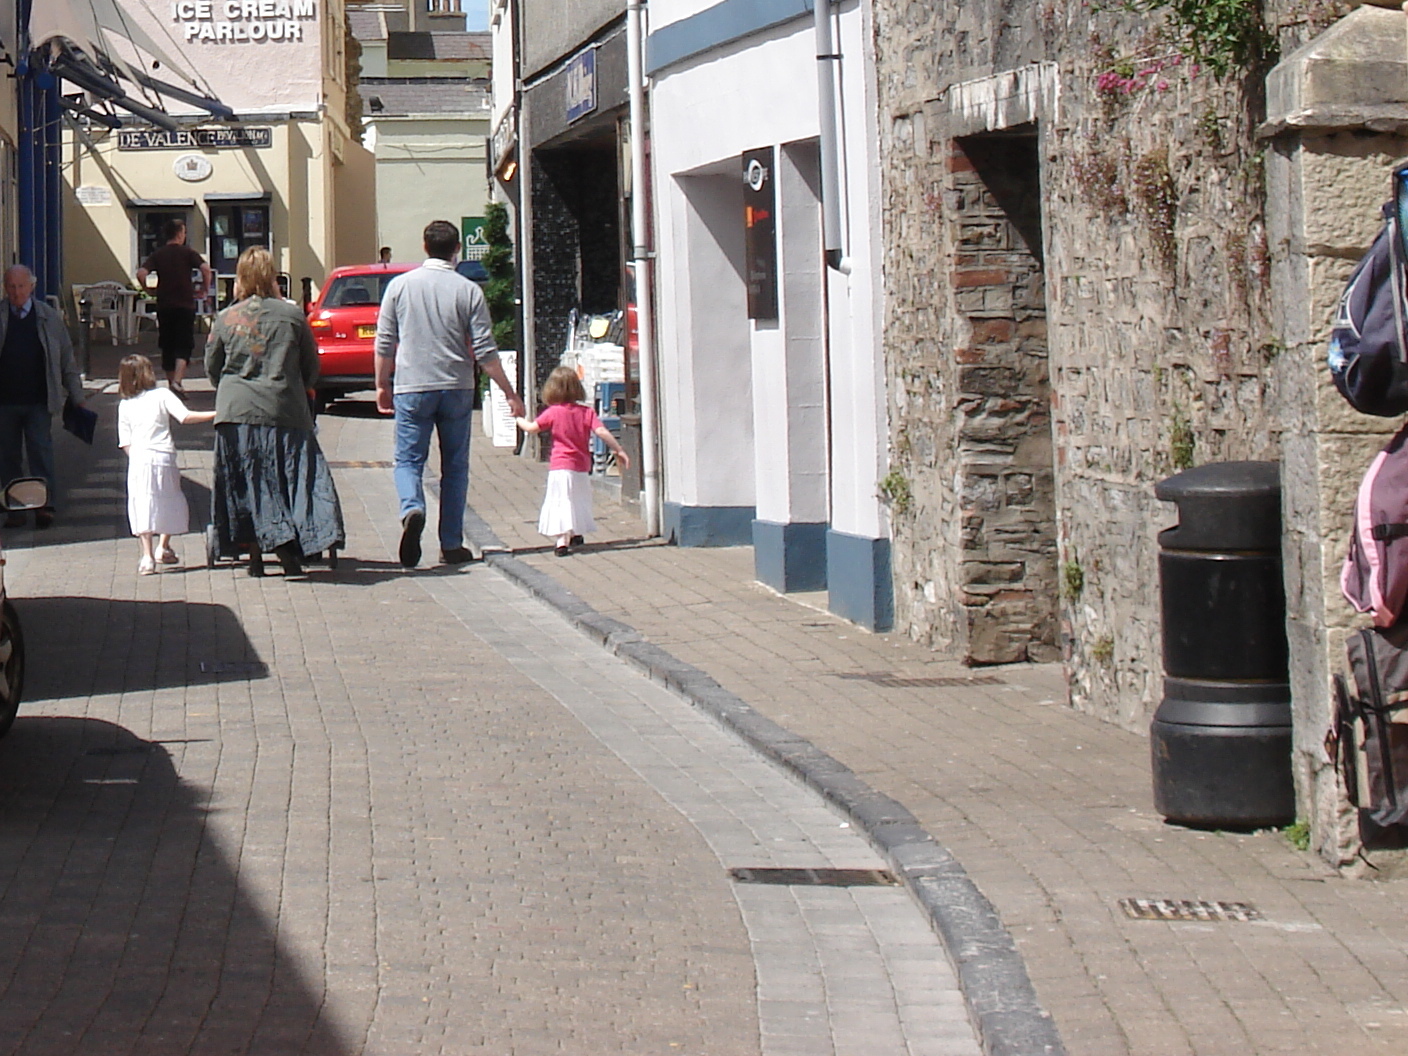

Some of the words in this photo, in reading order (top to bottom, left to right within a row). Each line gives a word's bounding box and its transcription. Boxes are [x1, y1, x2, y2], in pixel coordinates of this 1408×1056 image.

[172, 0, 211, 19] ICE
[223, 0, 314, 18] CREAM
[184, 21, 302, 40] PARLOUR
[120, 132, 141, 147] DE
[143, 130, 217, 147] VALENCE
